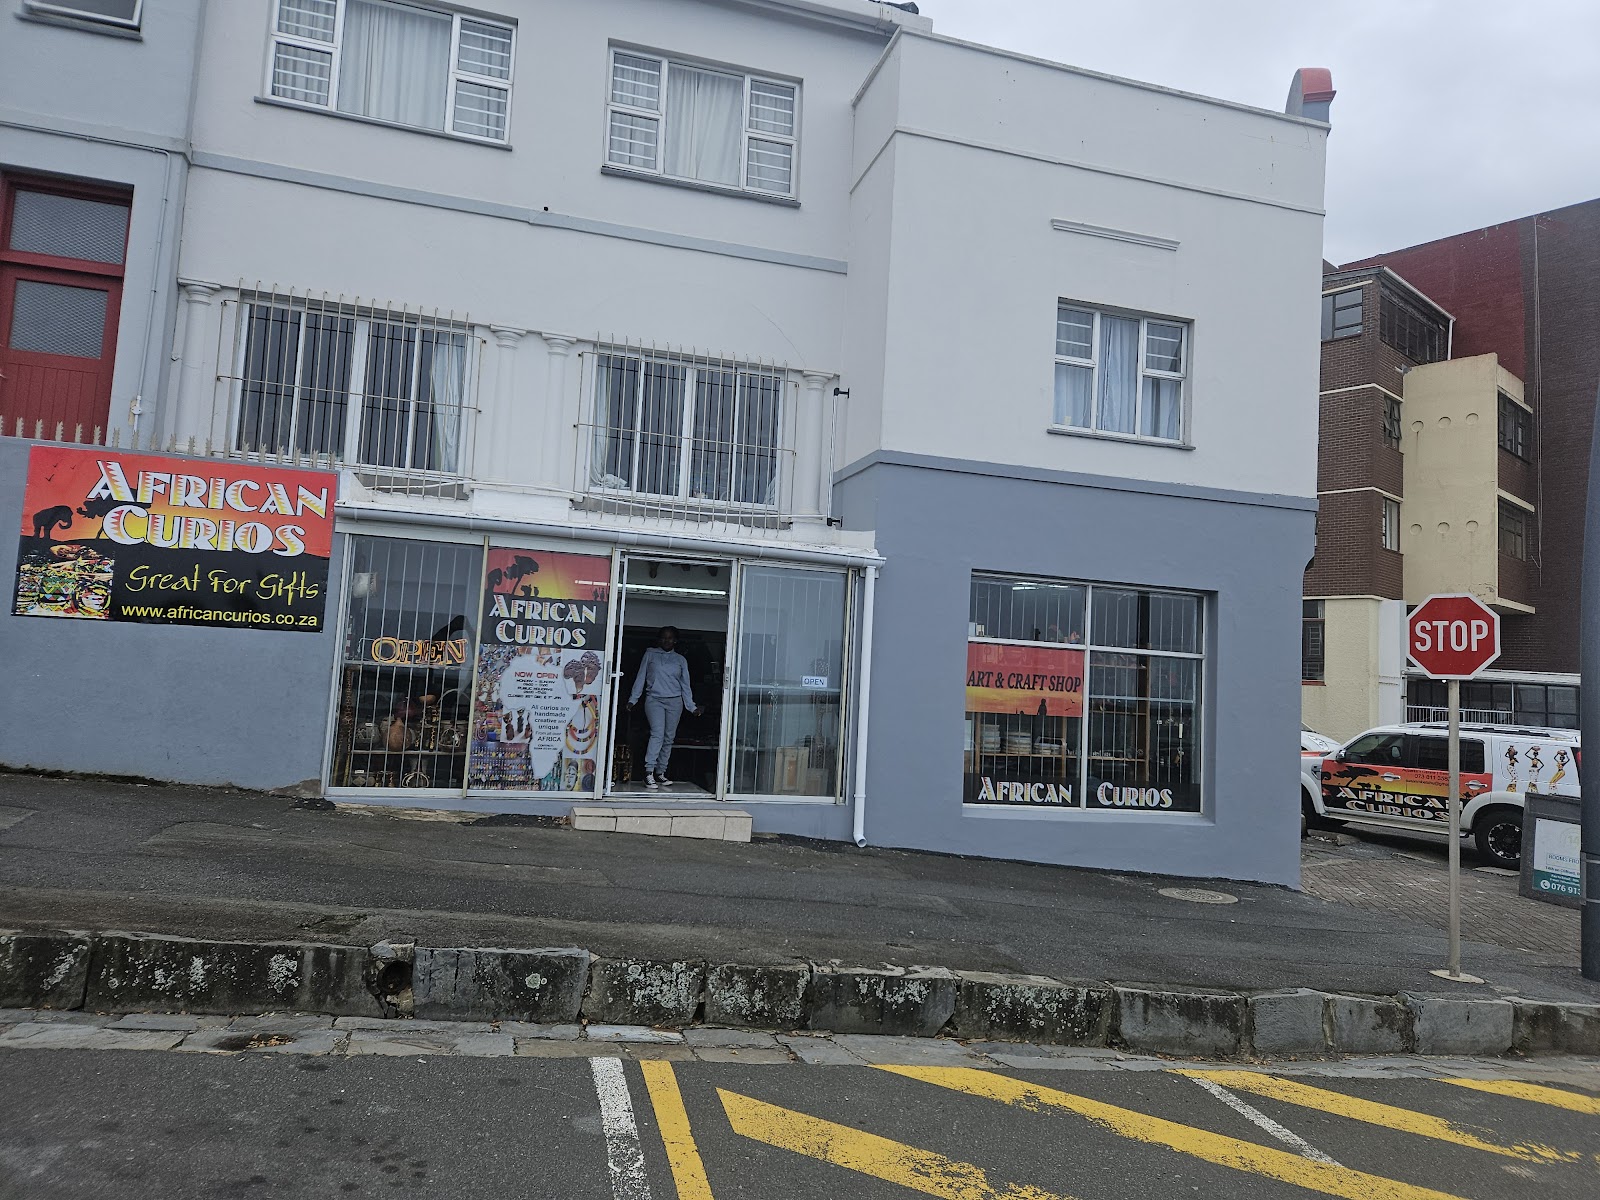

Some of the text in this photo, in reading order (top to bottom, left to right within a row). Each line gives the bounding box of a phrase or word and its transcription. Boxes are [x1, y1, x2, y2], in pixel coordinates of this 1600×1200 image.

[87, 460, 328, 520] AFRICAN
[103, 505, 305, 557] CURIOS
[125, 564, 319, 606] Great For Gifts
[121, 604, 318, 627] www.africancurios.co.za
[488, 594, 597, 625] AFRICAN
[495, 620, 586, 647] CURIOS
[1415, 620, 1489, 652] STOP
[371, 636, 467, 665] OPEN
[803, 678, 824, 686] OPEN
[966, 670, 1081, 692] ART & CRAFT SHOP
[978, 776, 1173, 808] AFRICAN CURIOS
[1346, 799, 1450, 823] CURIOS
[1551, 883, 1566, 892] 076
